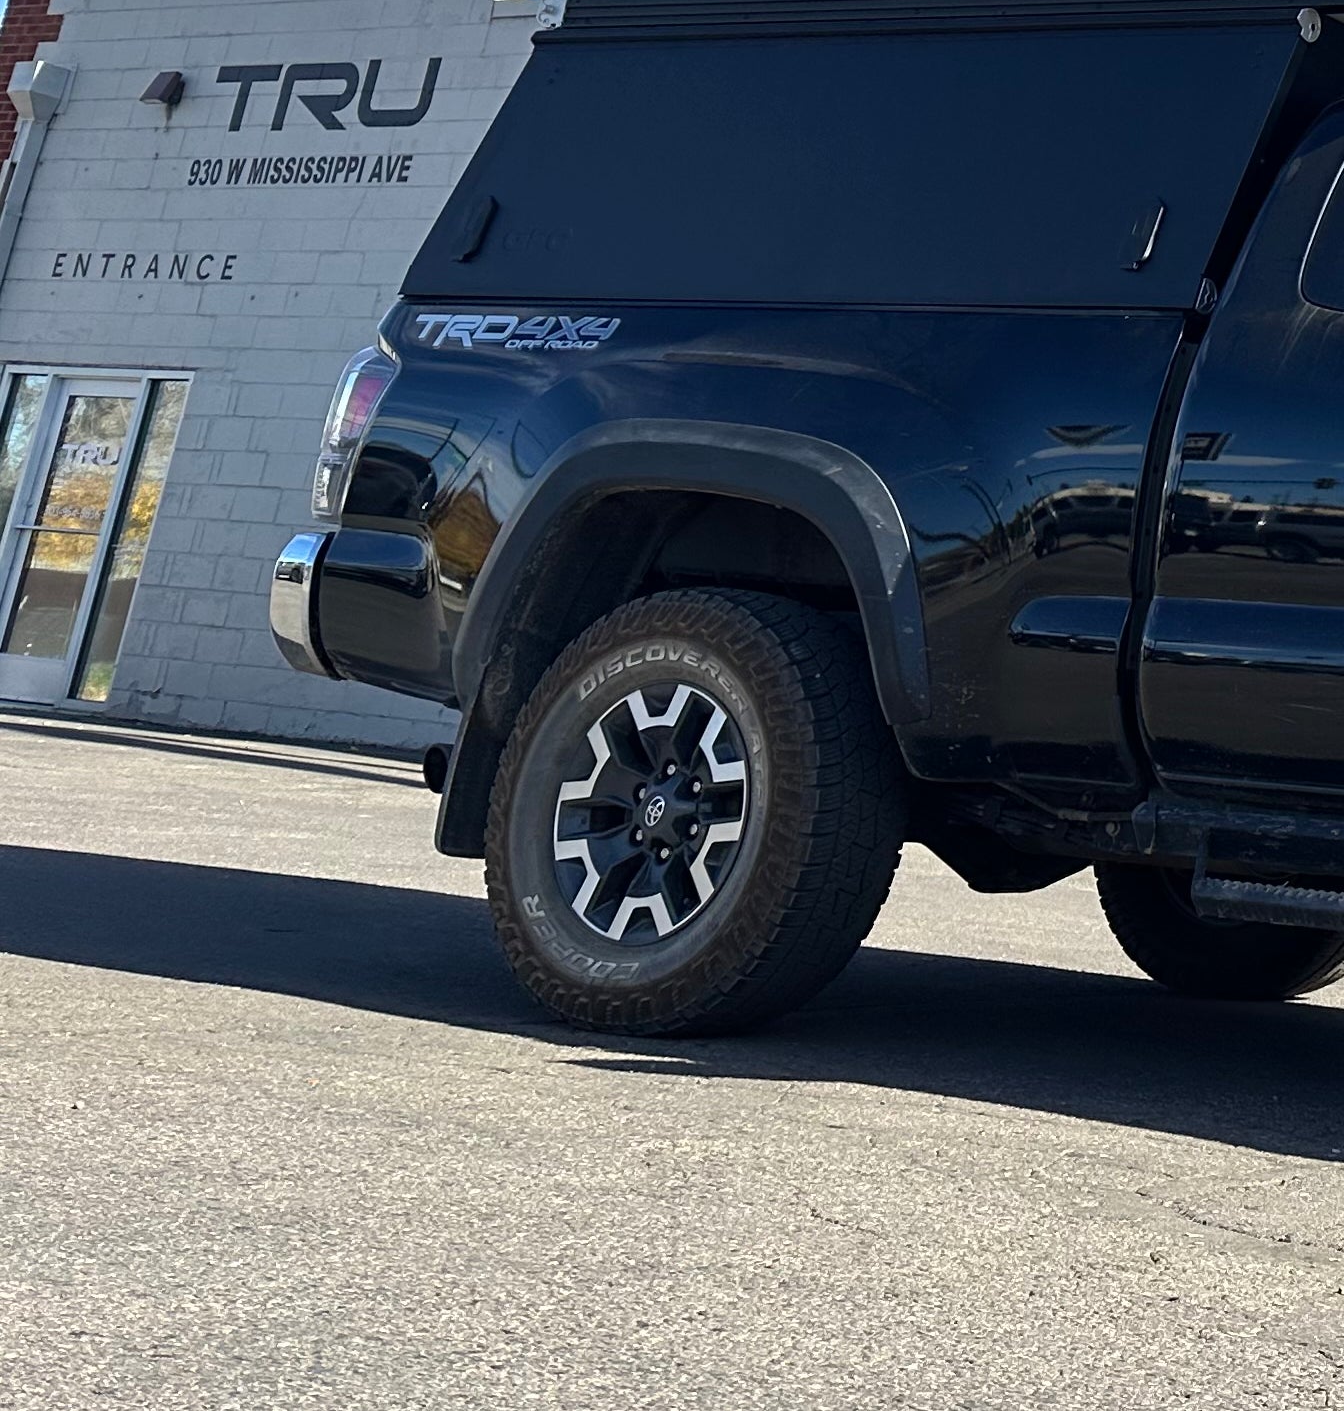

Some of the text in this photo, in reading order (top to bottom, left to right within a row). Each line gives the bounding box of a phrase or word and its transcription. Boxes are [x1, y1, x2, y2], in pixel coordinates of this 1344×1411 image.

[216, 57, 443, 131] TRU
[187, 154, 413, 186] 930 W MISSISSIPPI AVE
[51, 253, 240, 281] ENTRANCE
[416, 313, 520, 349] TRD
[504, 339, 600, 351] OFF ROAD
[61, 443, 122, 466] TRU
[579, 644, 748, 715] DISCOVERER
[522, 894, 640, 981] COOPER
